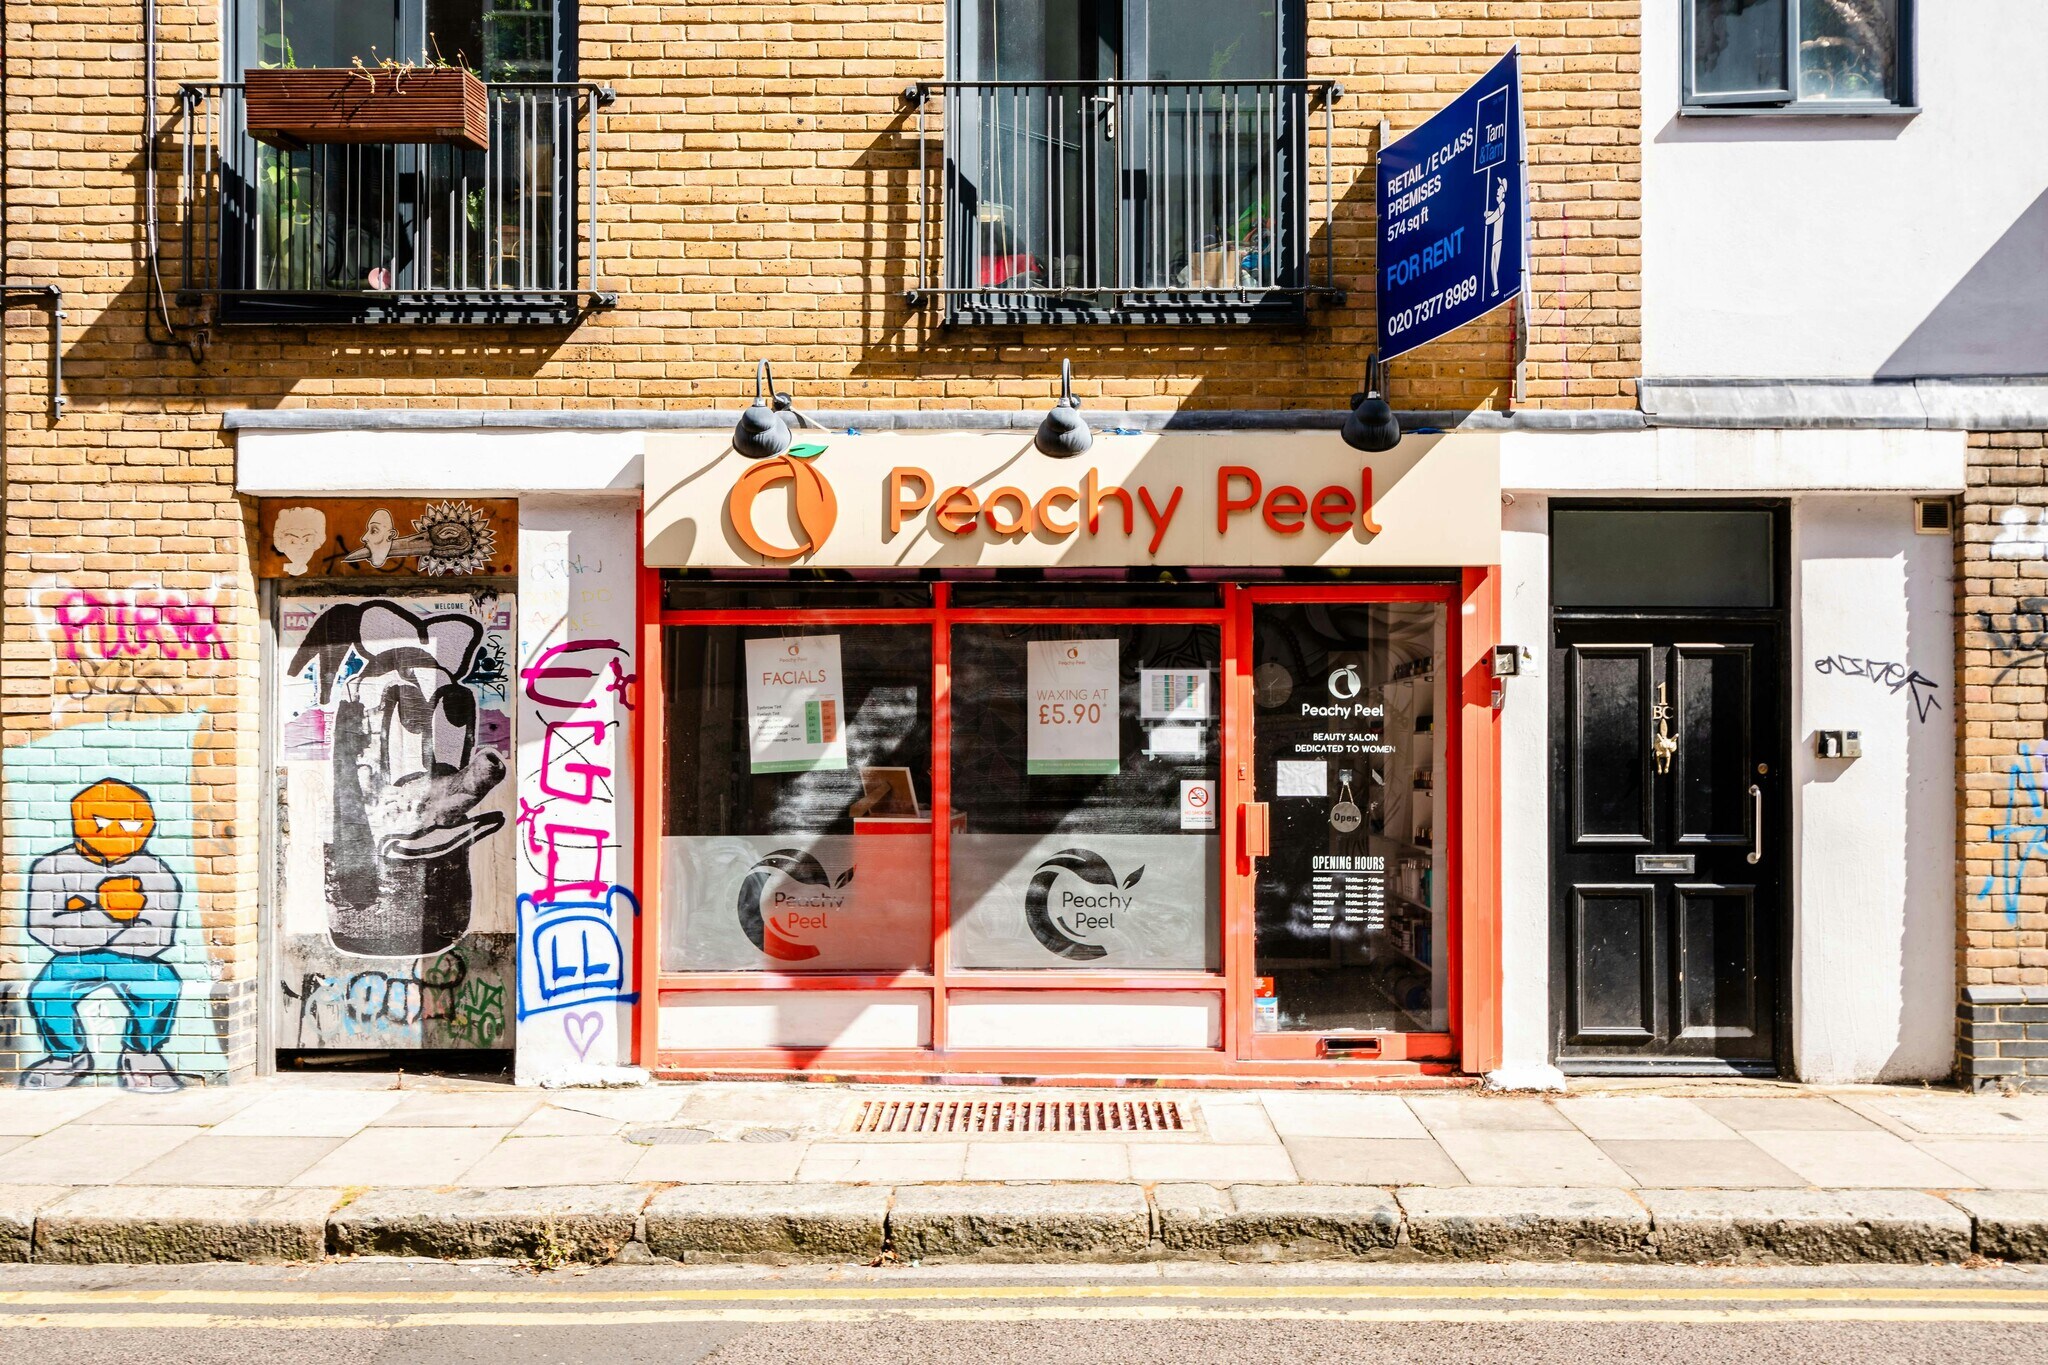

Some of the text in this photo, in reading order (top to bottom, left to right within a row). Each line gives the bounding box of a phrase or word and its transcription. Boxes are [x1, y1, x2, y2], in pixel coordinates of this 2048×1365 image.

[1388, 167, 1425, 198] RETAIL
[1432, 151, 1439, 172] E
[1440, 127, 1474, 166] CLASS
[1388, 175, 1441, 220] PREMISES
[1387, 206, 1429, 241] 574 sq ft
[1387, 226, 1464, 291] FOR RENT
[1388, 309, 1413, 336] 020
[1415, 290, 1445, 324] 7377
[1445, 275, 1477, 310] 8989
[890, 465, 1383, 554] Peachy Peel
[762, 669, 827, 686] FACIALS
[1037, 688, 1109, 701] WAXING AT
[1657, 681, 1668, 706] 1
[1302, 703, 1384, 720] Peachy Peel
[1652, 705, 1674, 720] BC
[1313, 732, 1346, 741] BEAUTY
[1348, 733, 1378, 741] SALON
[1295, 744, 1396, 753] DEDICATED TO WOMEN
[1334, 812, 1358, 823] Open
[1312, 855, 1385, 870] OPENING HOURS
[774, 892, 845, 912] Peachy
[1062, 891, 1132, 912] Peachy
[788, 912, 828, 928] Peel
[1076, 912, 1115, 928] Peel
